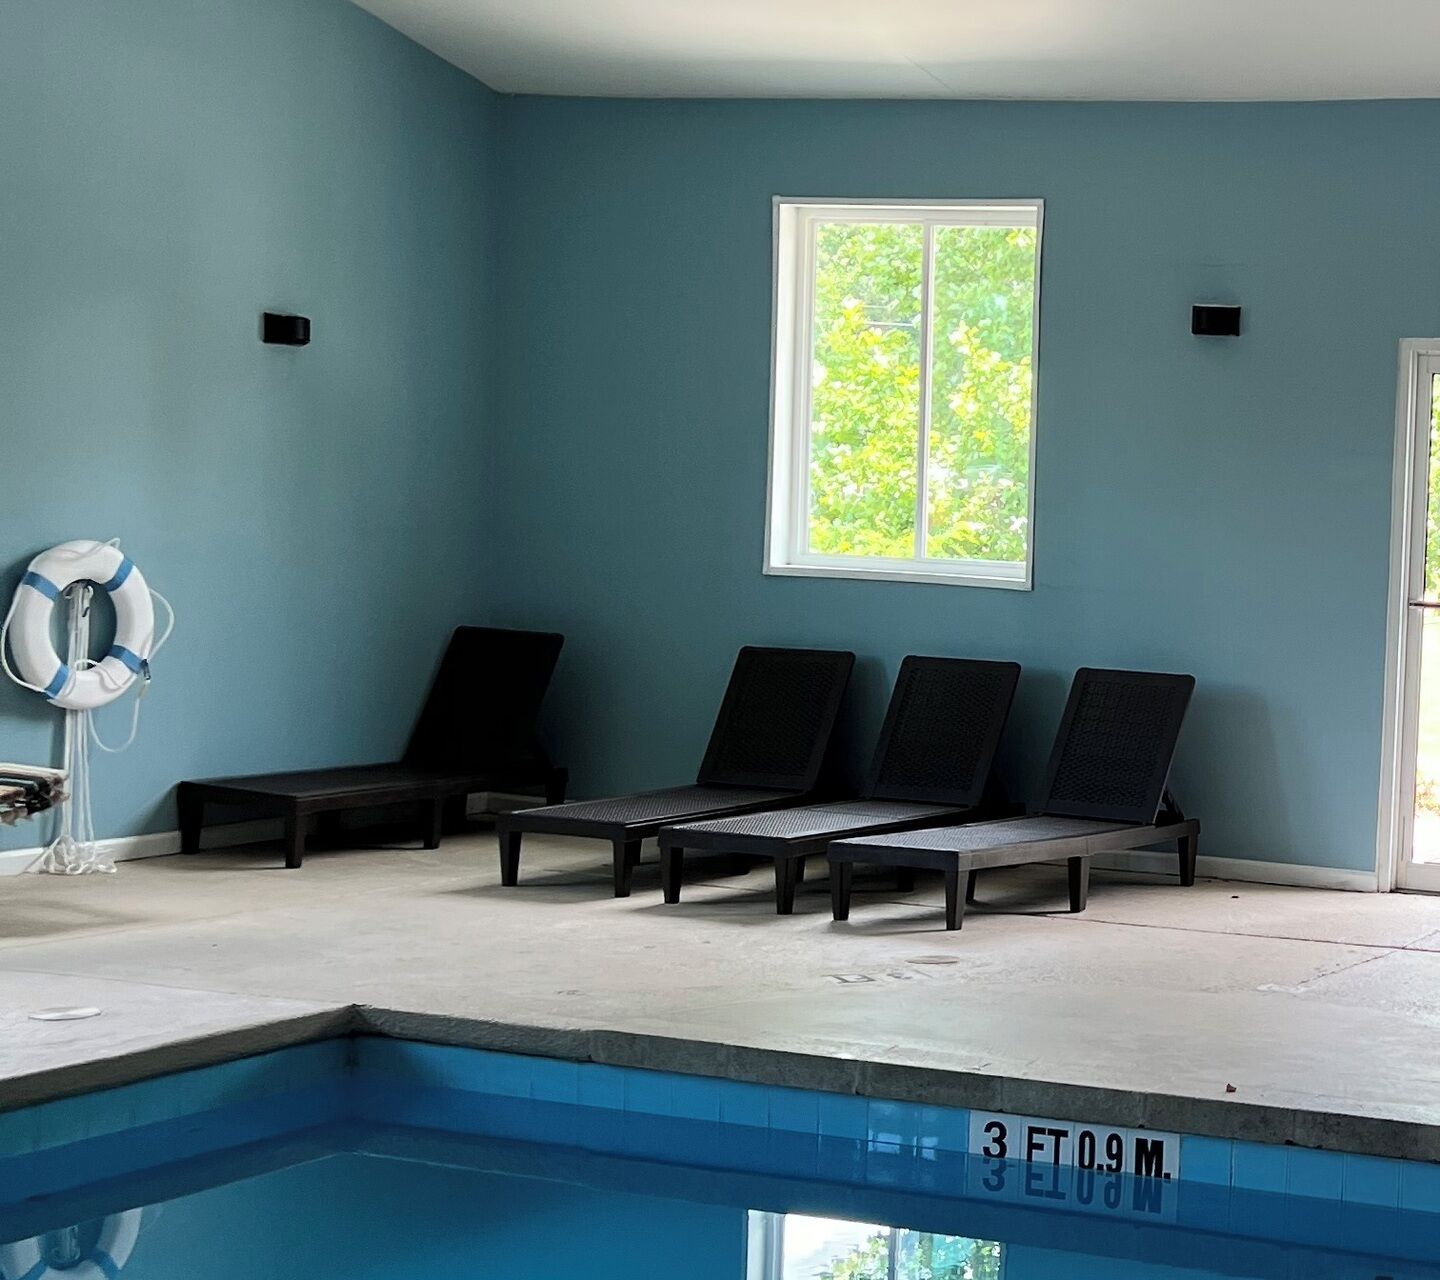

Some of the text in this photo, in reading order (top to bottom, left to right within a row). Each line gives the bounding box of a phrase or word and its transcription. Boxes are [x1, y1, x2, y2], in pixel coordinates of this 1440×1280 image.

[982, 1120, 1007, 1158] 3
[1027, 1126, 1069, 1166] FT
[1078, 1130, 1123, 1173] 0.9
